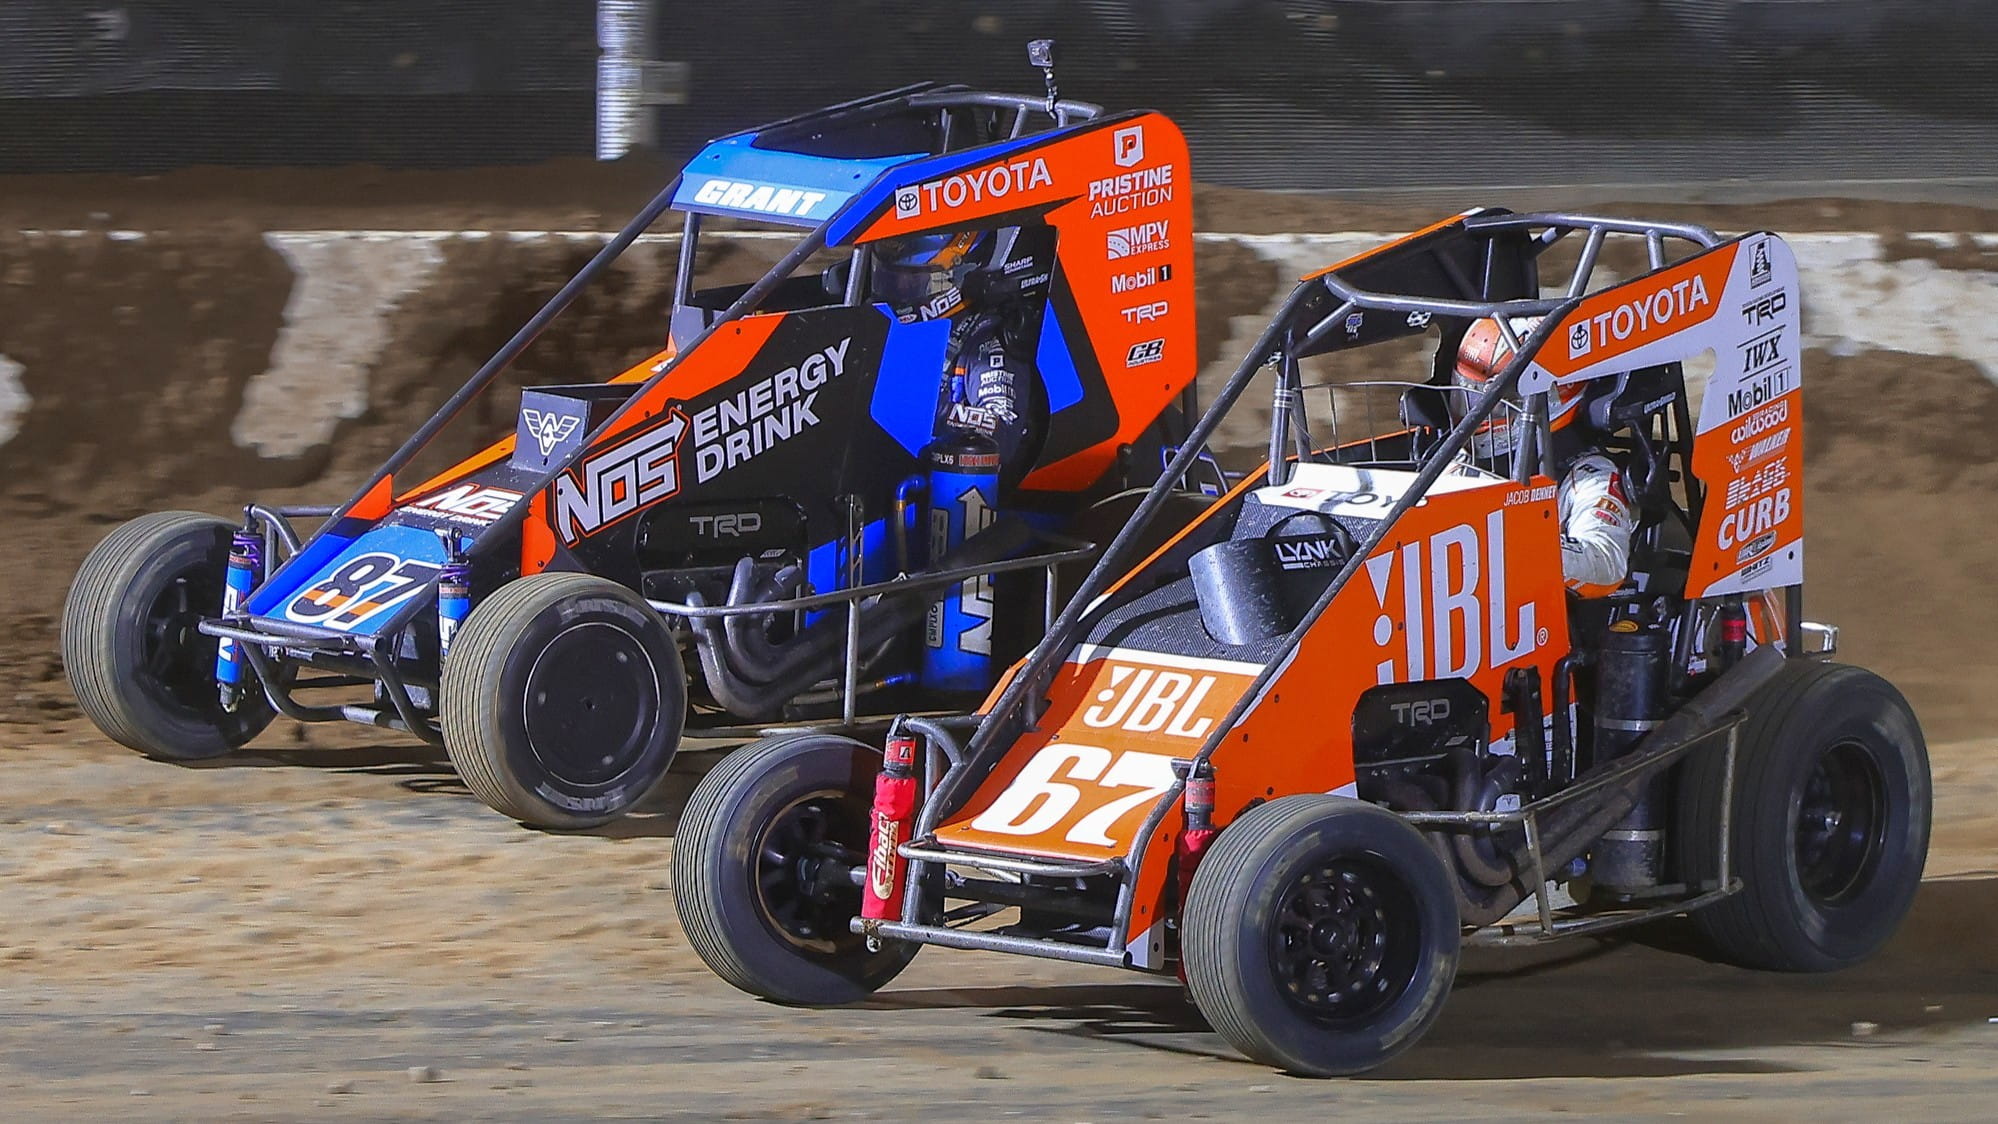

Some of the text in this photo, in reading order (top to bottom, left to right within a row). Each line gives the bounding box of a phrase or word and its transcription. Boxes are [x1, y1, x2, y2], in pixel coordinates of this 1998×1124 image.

[693, 178, 826, 217] GRANT
[922, 158, 1052, 212] TOYOTA
[1088, 164, 1173, 201] PRISTINE
[1090, 185, 1173, 219] AUCTION
[1130, 220, 1169, 246] MPV
[1130, 239, 1170, 256] EXPRESS
[1004, 255, 1033, 270] SHARP
[1111, 268, 1155, 294] Mobil
[919, 287, 962, 322] NOS
[1121, 301, 1168, 324] TRD
[1593, 275, 1710, 348] TOYOTA
[1742, 292, 1786, 326] TRD
[1743, 334, 1782, 374] IWX
[694, 337, 851, 448] ENERGY
[1728, 375, 1771, 418] Mobil
[949, 403, 996, 430] NOS
[1731, 399, 1788, 444] wilwood
[697, 391, 820, 484] DRINK
[556, 412, 687, 544] NOS
[414, 484, 524, 520] NOS
[1503, 489, 1531, 507] JACOB
[690, 512, 761, 539] TRD
[1718, 487, 1790, 551] CURB
[1275, 539, 1342, 562] LYNK
[1303, 559, 1345, 568] CHASSIS
[284, 551, 442, 632] 87
[1376, 509, 1536, 686] JBL
[1083, 668, 1217, 739] JBL
[1391, 698, 1450, 727] TRD
[970, 743, 1183, 848] 67
